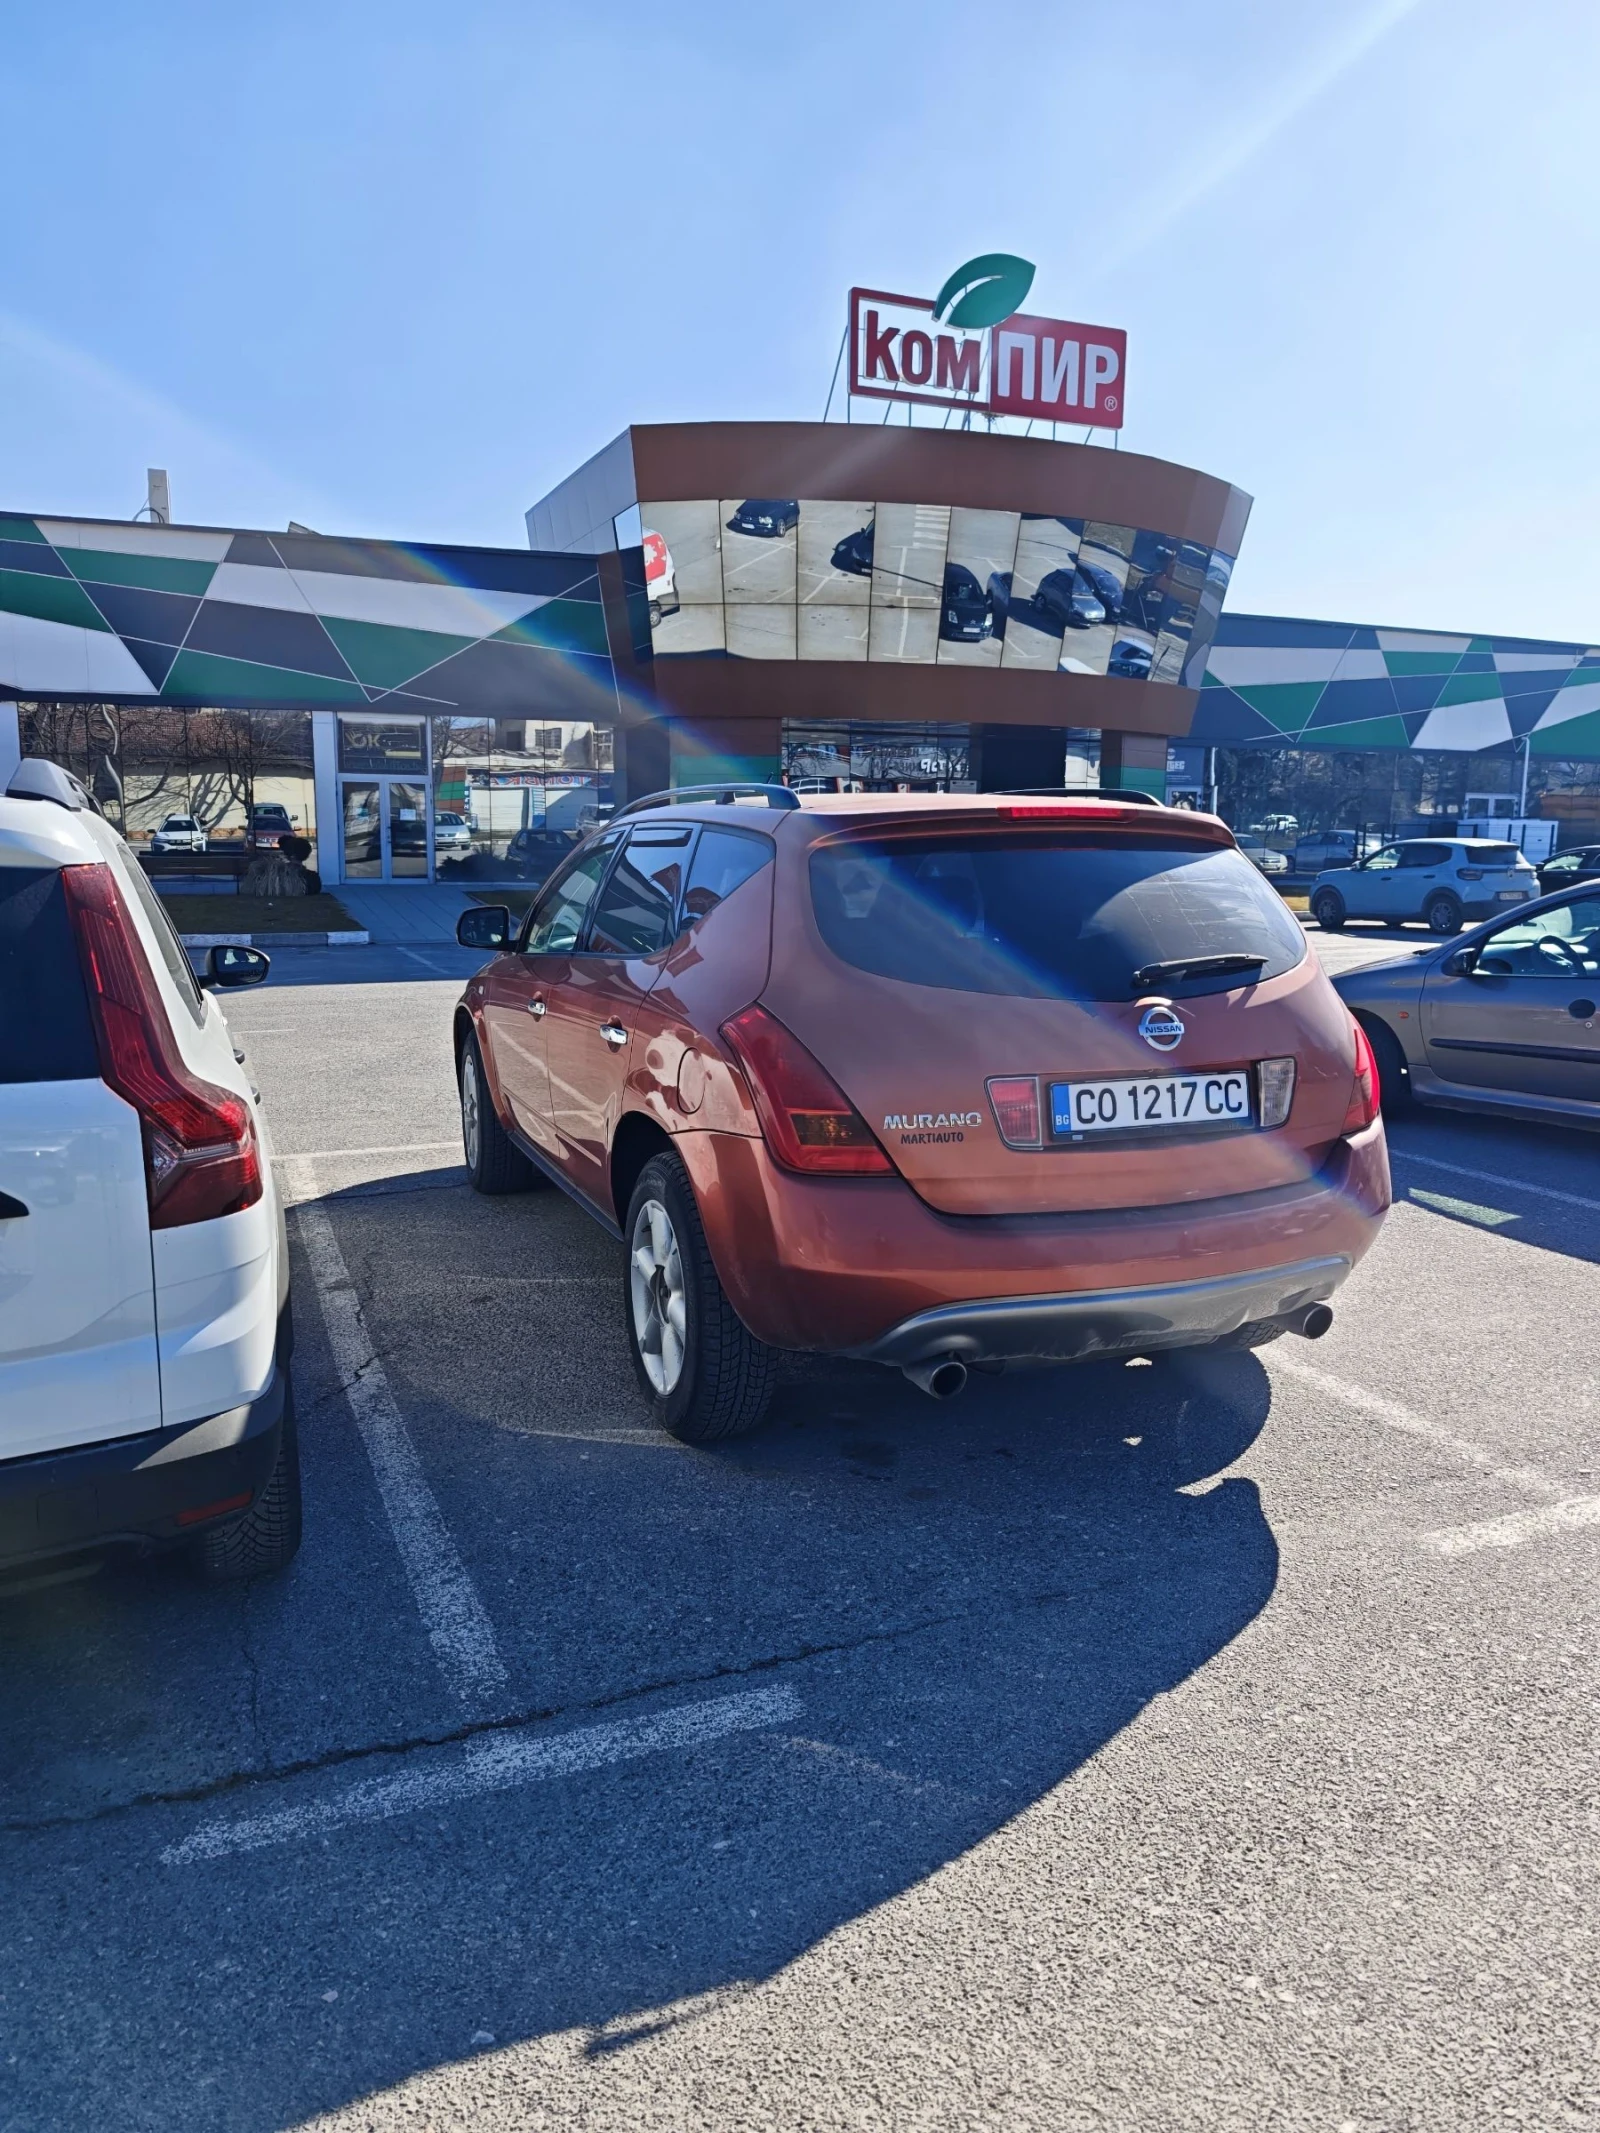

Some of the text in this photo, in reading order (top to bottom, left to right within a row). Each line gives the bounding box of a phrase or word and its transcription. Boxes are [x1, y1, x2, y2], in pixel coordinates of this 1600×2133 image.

[1145, 1025, 1182, 1034] NISSAN
[1076, 1078, 1243, 1125] CO 1217 CC
[883, 1111, 983, 1130] MURANO
[1055, 1114, 1070, 1126] BG
[900, 1132, 964, 1145] MARTIAUTO
